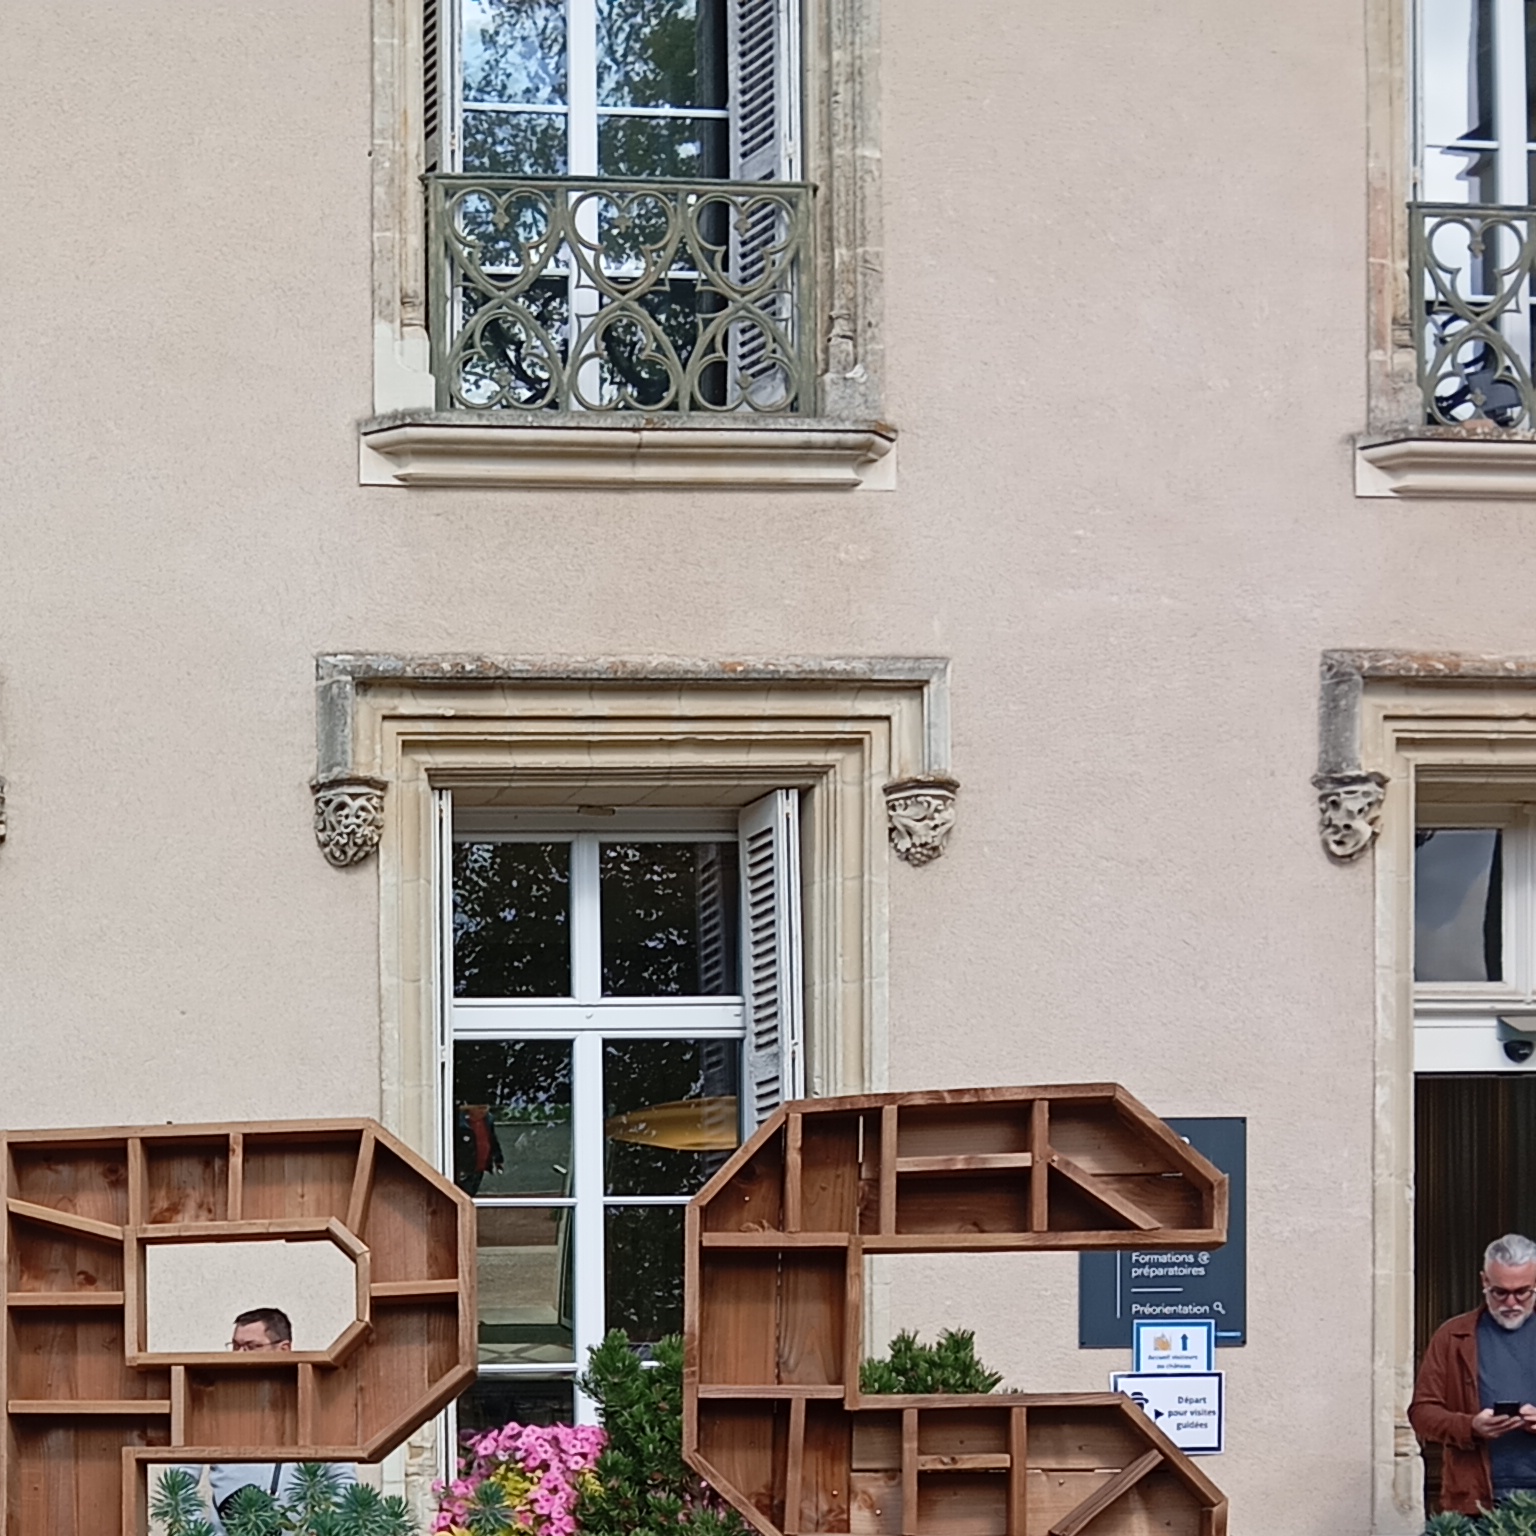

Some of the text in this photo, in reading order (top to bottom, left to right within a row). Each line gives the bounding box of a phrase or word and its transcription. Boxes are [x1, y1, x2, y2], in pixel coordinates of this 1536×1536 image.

[1131, 1251, 1195, 1264] Formations
[1131, 1264, 1206, 1279] préparatoires
[1131, 1302, 1210, 1315] Préorientation
[1177, 1396, 1207, 1405] Départ
[1168, 1408, 1216, 1418] pour visites
[1176, 1421, 1208, 1431] guidées
